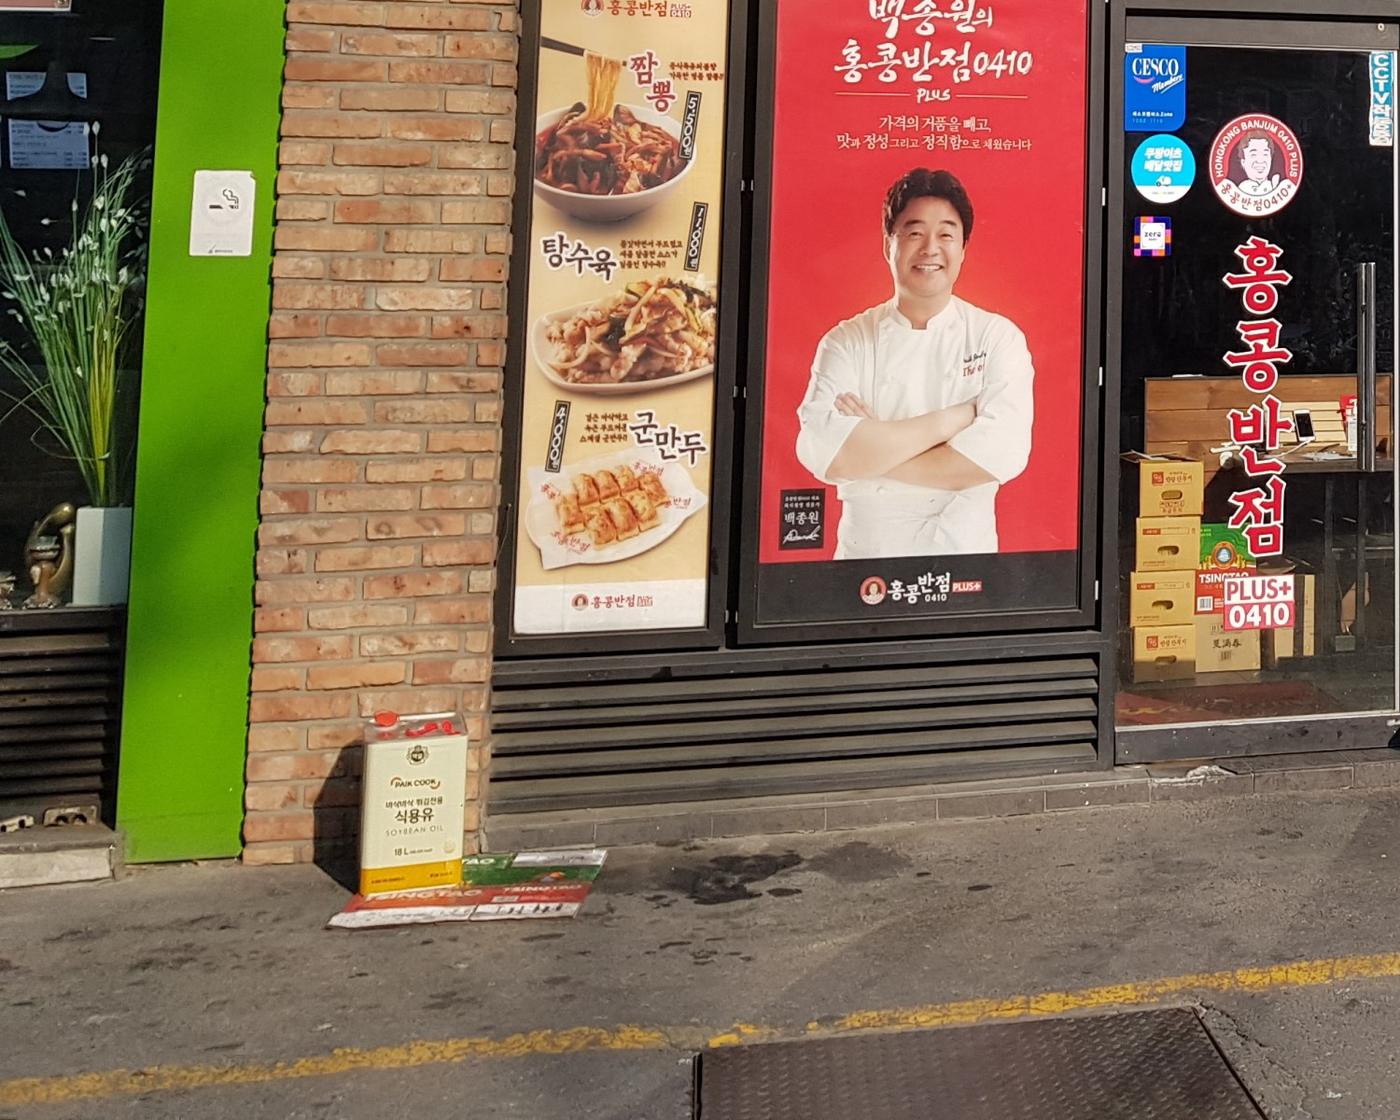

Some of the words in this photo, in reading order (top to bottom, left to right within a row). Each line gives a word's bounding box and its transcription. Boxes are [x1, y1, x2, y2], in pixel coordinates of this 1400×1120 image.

[833, 39, 1033, 83] 홍콩반점0410
[1132, 57, 1179, 76] CESCO
[630, 51, 676, 113] 짬뽕
[916, 88, 951, 103] PLUS
[879, 115, 919, 131] 가격의
[921, 116, 961, 132] 거품을
[836, 134, 860, 150] 맛과
[863, 134, 889, 150] 정성
[890, 137, 920, 149] 그리고
[921, 134, 981, 151] 정직함으로
[1215, 126, 1241, 178] HONGKONG
[1240, 119, 1279, 134] BANJUM
[1278, 130, 1295, 151] 0410
[1289, 152, 1299, 177] PLUS
[1144, 146, 1183, 160] 쿠팡이츠
[1143, 159, 1183, 173] 배달맛집
[542, 234, 617, 281] 탕수육
[1222, 235, 1294, 559] 홍콩반점
[629, 411, 707, 465] 군만두
[784, 510, 820, 526] 백종원
[887, 571, 951, 604] 홍콩반점
[591, 594, 635, 609] 홍콩반점
[924, 592, 947, 602] 0410
[1229, 602, 1291, 628] 0410
[414, 779, 436, 787] COOK
[394, 807, 434, 825] 식용유
[429, 825, 444, 833] OIL
